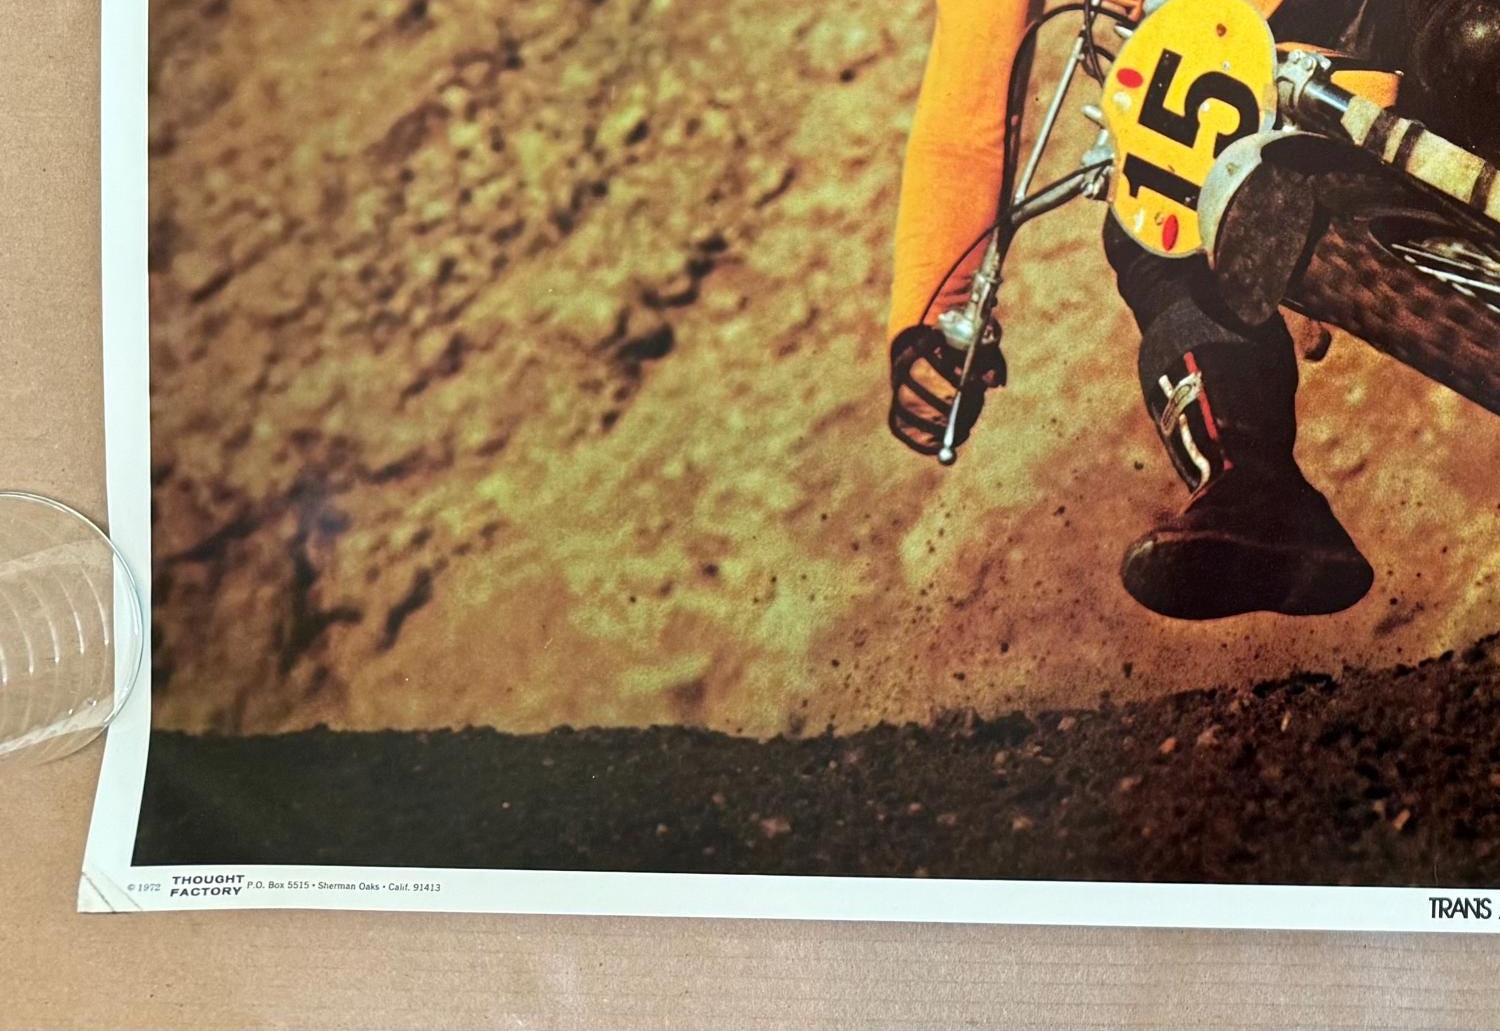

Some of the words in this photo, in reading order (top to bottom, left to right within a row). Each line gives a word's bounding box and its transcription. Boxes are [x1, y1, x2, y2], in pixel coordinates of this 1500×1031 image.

[1123, 48, 1260, 211] 15
[172, 874, 245, 885] THOUGHT
[138, 883, 161, 892] 1972
[170, 886, 242, 897] FACTORY
[246, 881, 265, 889] P.O.
[268, 881, 284, 889] Box
[287, 881, 309, 889] 5515
[318, 881, 356, 890] Sherman
[359, 882, 380, 891] Oaks
[388, 882, 410, 892] Calif.
[413, 883, 441, 892] 91413
[1428, 897, 1492, 919] TRANS
